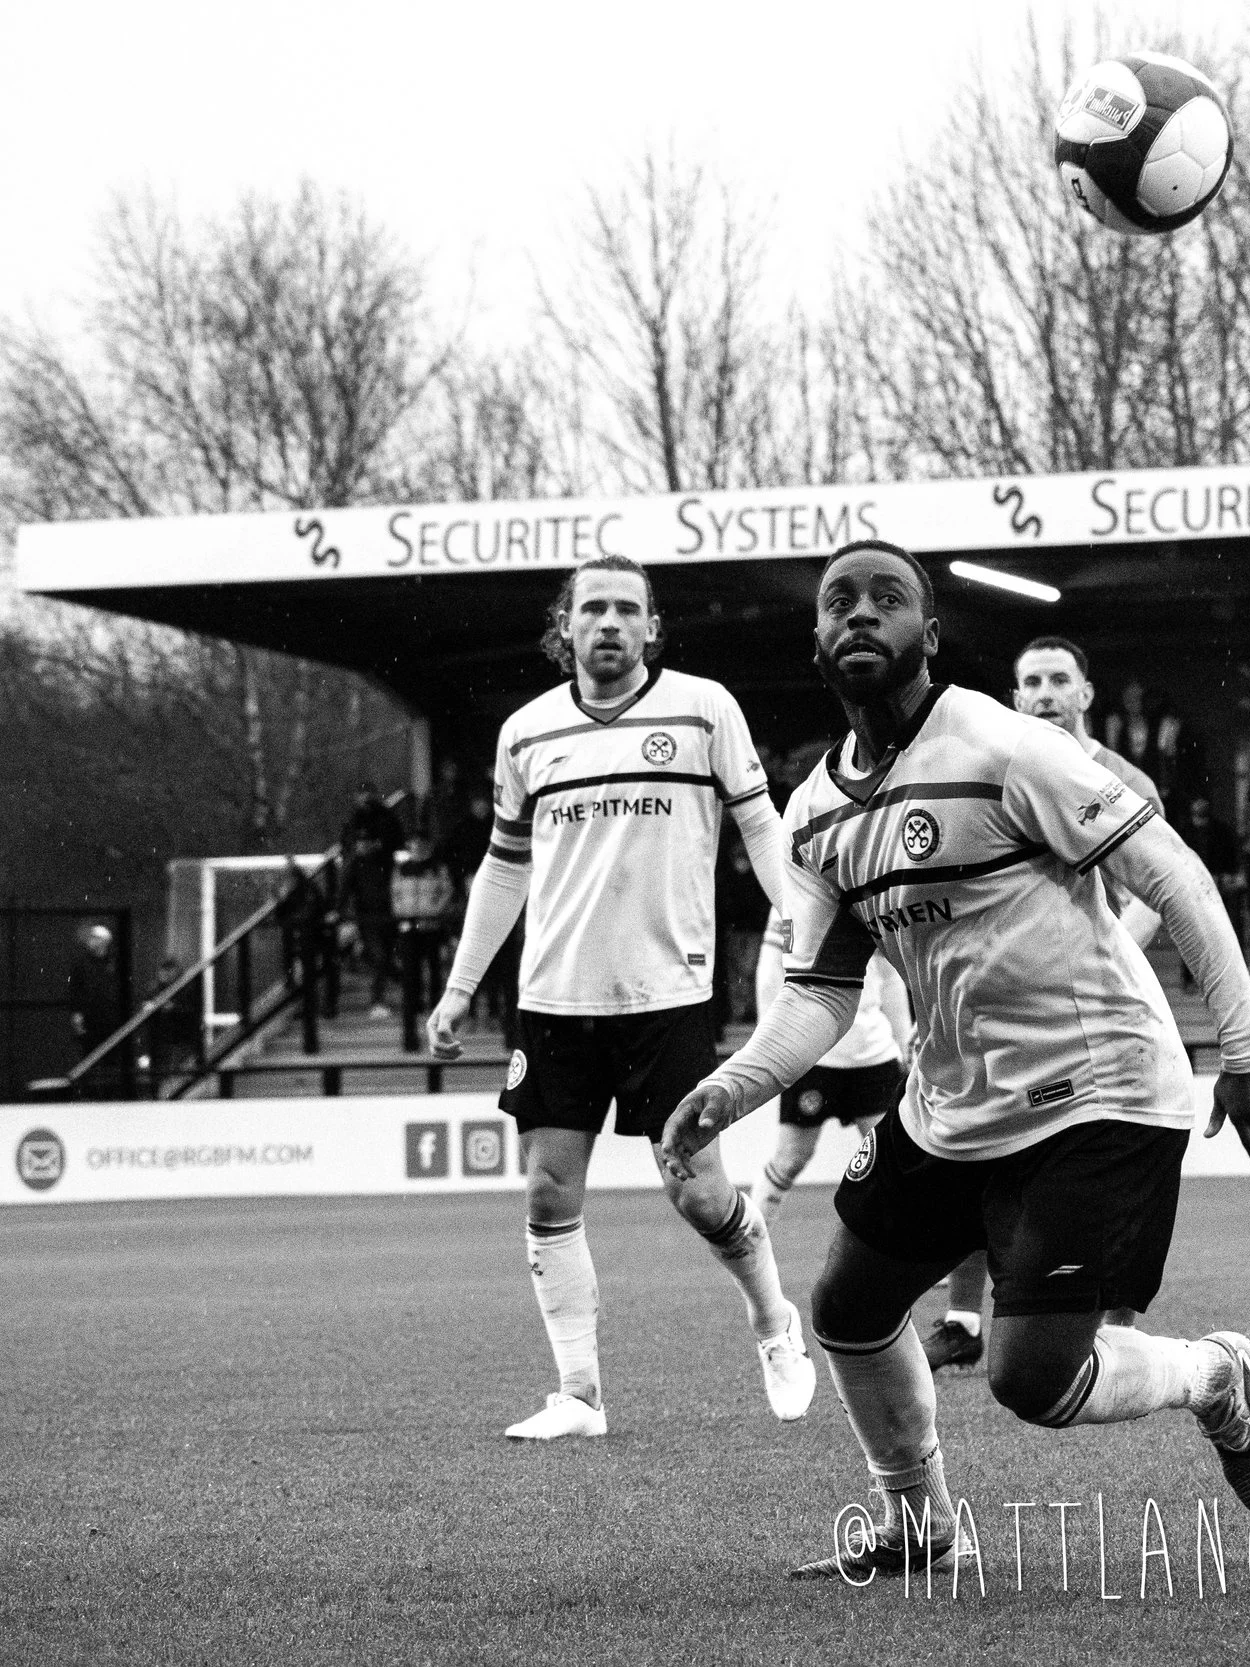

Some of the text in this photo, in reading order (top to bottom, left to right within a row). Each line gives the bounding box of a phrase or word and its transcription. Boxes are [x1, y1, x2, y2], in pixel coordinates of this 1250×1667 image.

[387, 500, 878, 568] SECURITEC SYSTEMS
[551, 798, 672, 826] THE PITMEN
